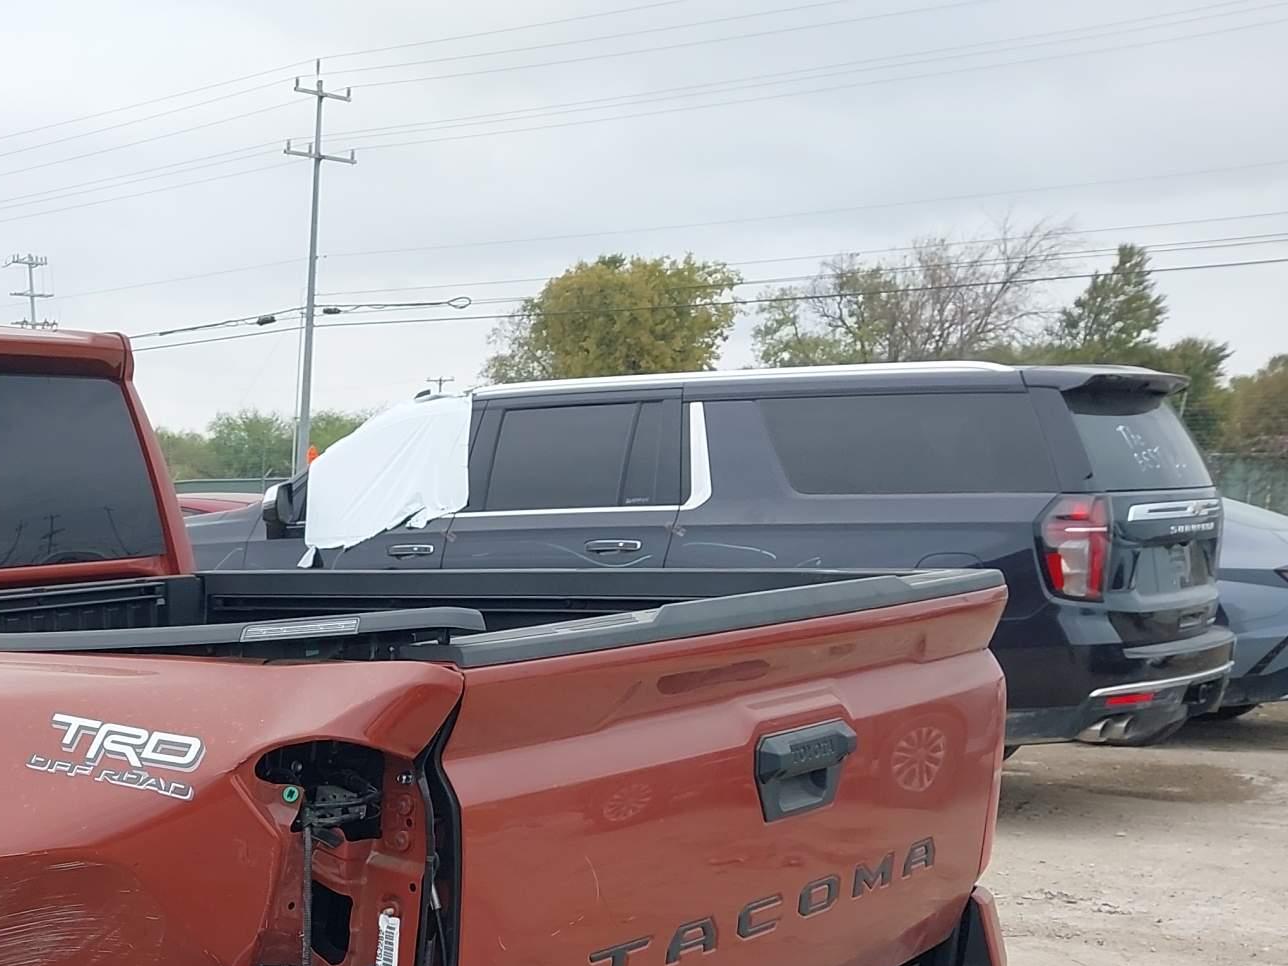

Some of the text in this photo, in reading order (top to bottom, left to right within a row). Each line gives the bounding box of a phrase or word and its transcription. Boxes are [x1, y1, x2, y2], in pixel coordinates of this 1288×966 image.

[51, 713, 206, 773] TRD
[25, 754, 194, 801] OFF ROAD
